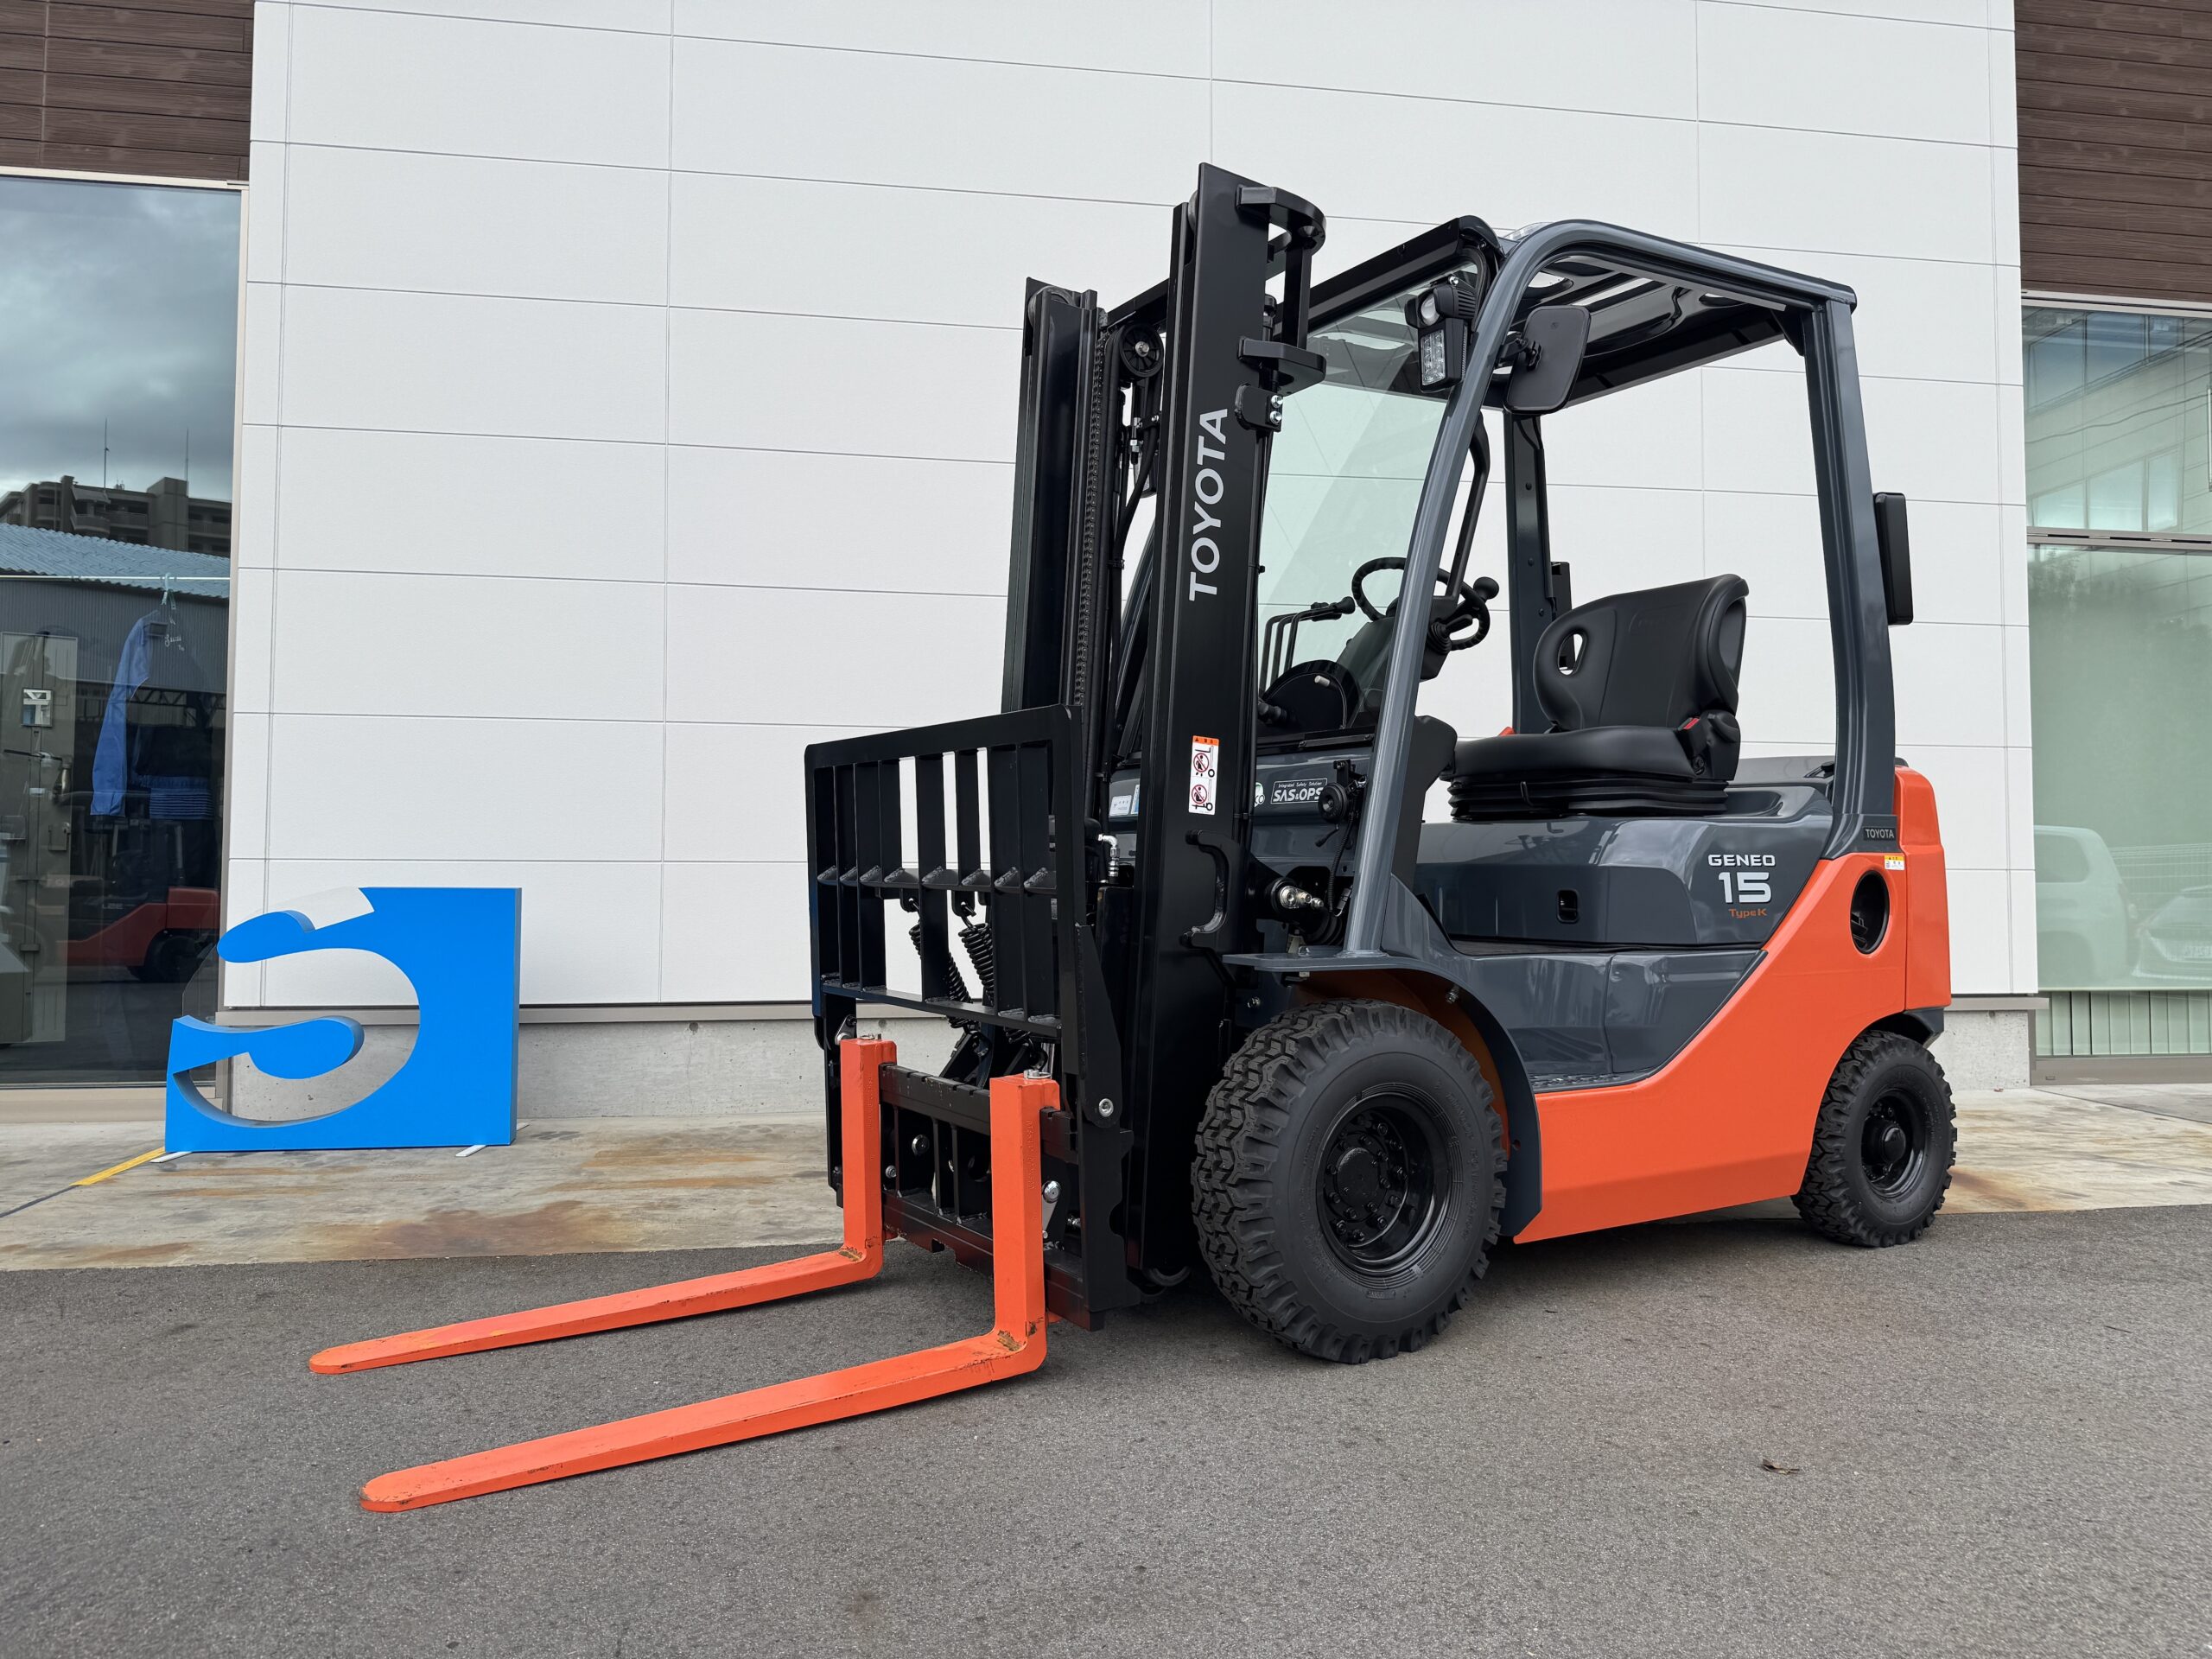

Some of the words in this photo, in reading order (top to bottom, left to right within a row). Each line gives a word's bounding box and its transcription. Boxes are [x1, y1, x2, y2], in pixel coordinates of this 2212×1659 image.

[1189, 409, 1228, 601] TOYOTA
[1866, 829, 1895, 839] TOYOTA
[1708, 855, 1776, 867] GENEO
[1718, 872, 1771, 903] 15
